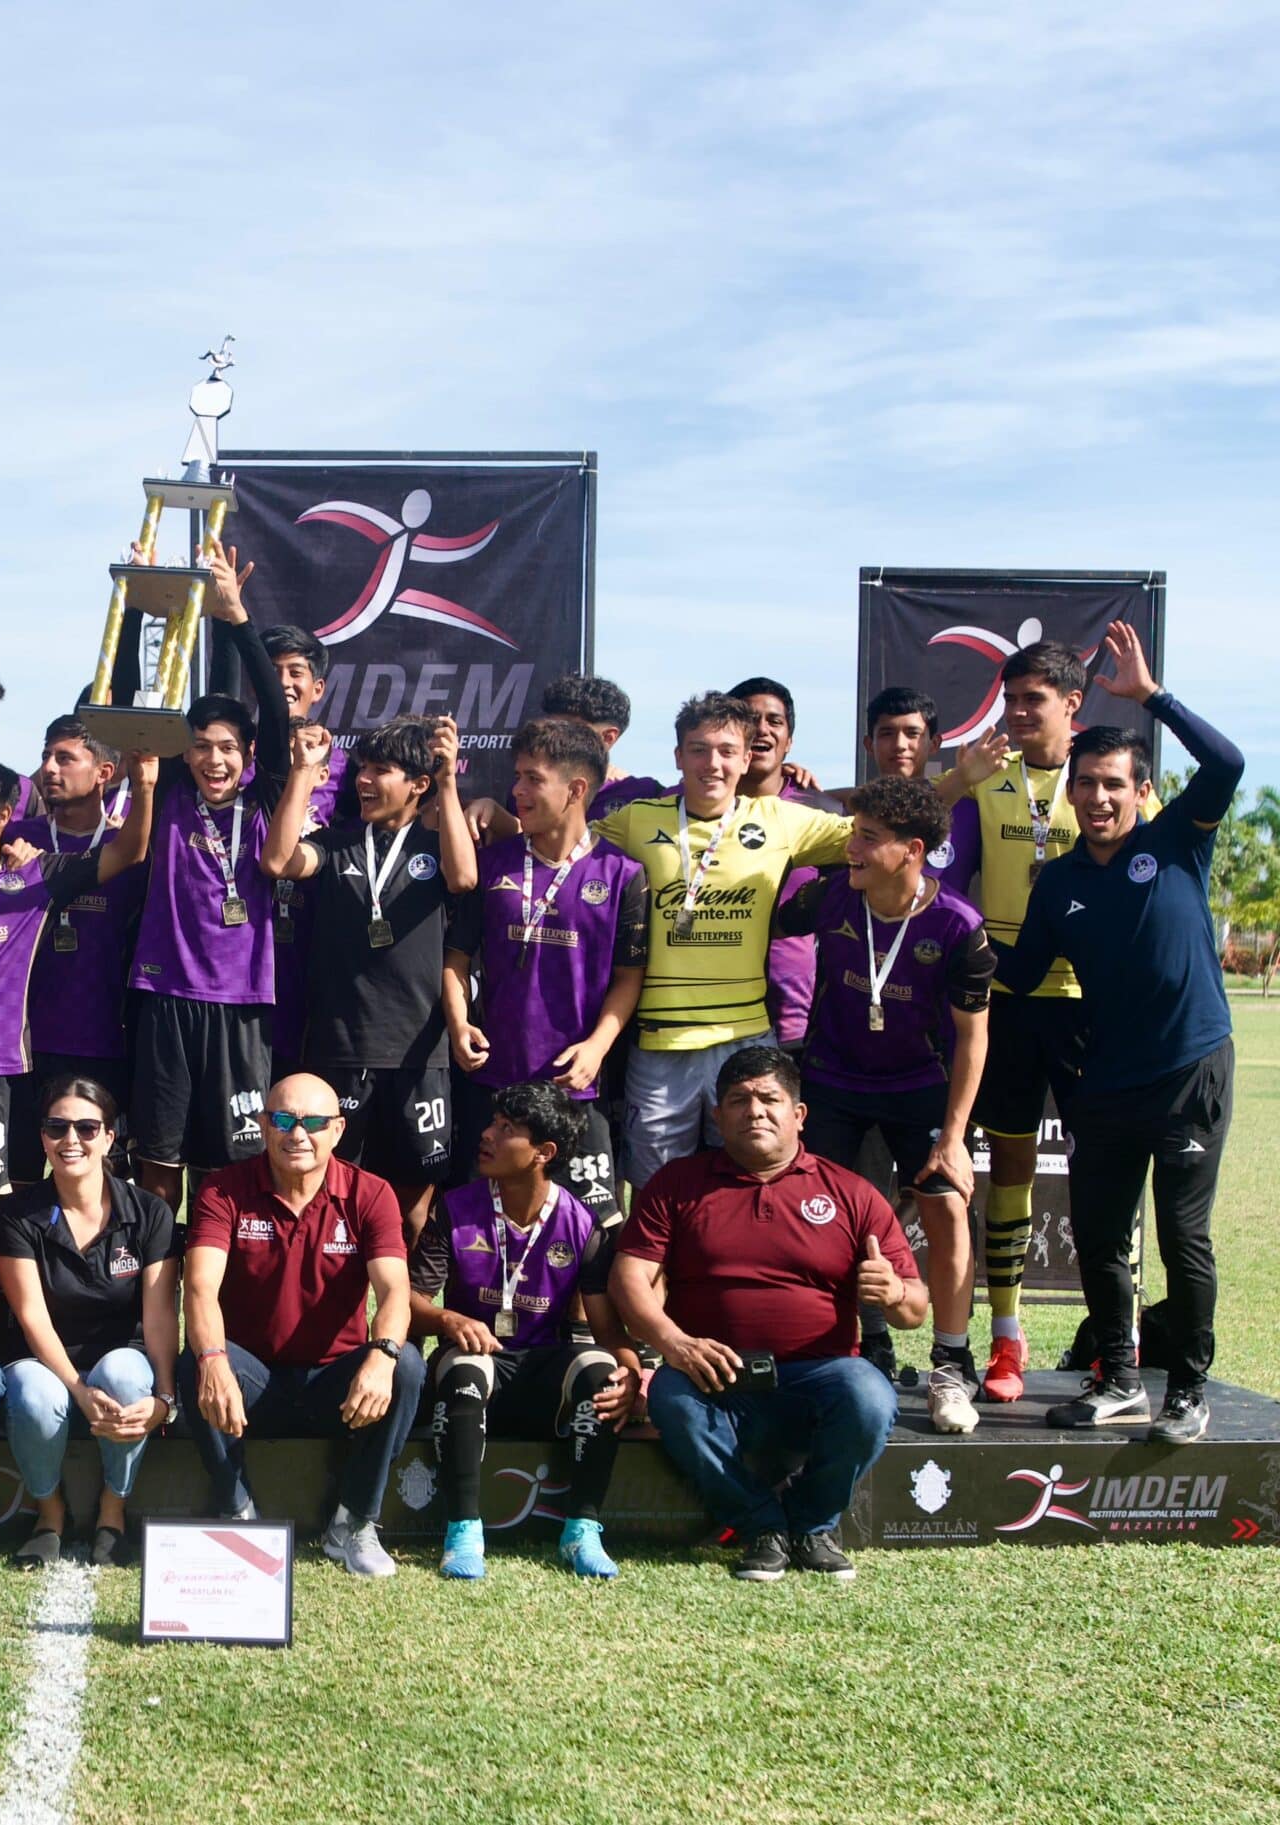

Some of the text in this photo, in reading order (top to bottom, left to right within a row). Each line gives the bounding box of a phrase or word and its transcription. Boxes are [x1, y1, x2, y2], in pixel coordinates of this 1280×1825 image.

[415, 1098, 445, 1133] 20
[250, 1220, 273, 1232] ISDE
[1090, 1475, 1228, 1508] IMDEM
[1088, 1510, 1218, 1518] INSTITUTO MUNICIPAL DEL DEPORTE
[883, 1518, 978, 1534] MAZATLÁN
[1109, 1520, 1197, 1531] MAZATLÁN
